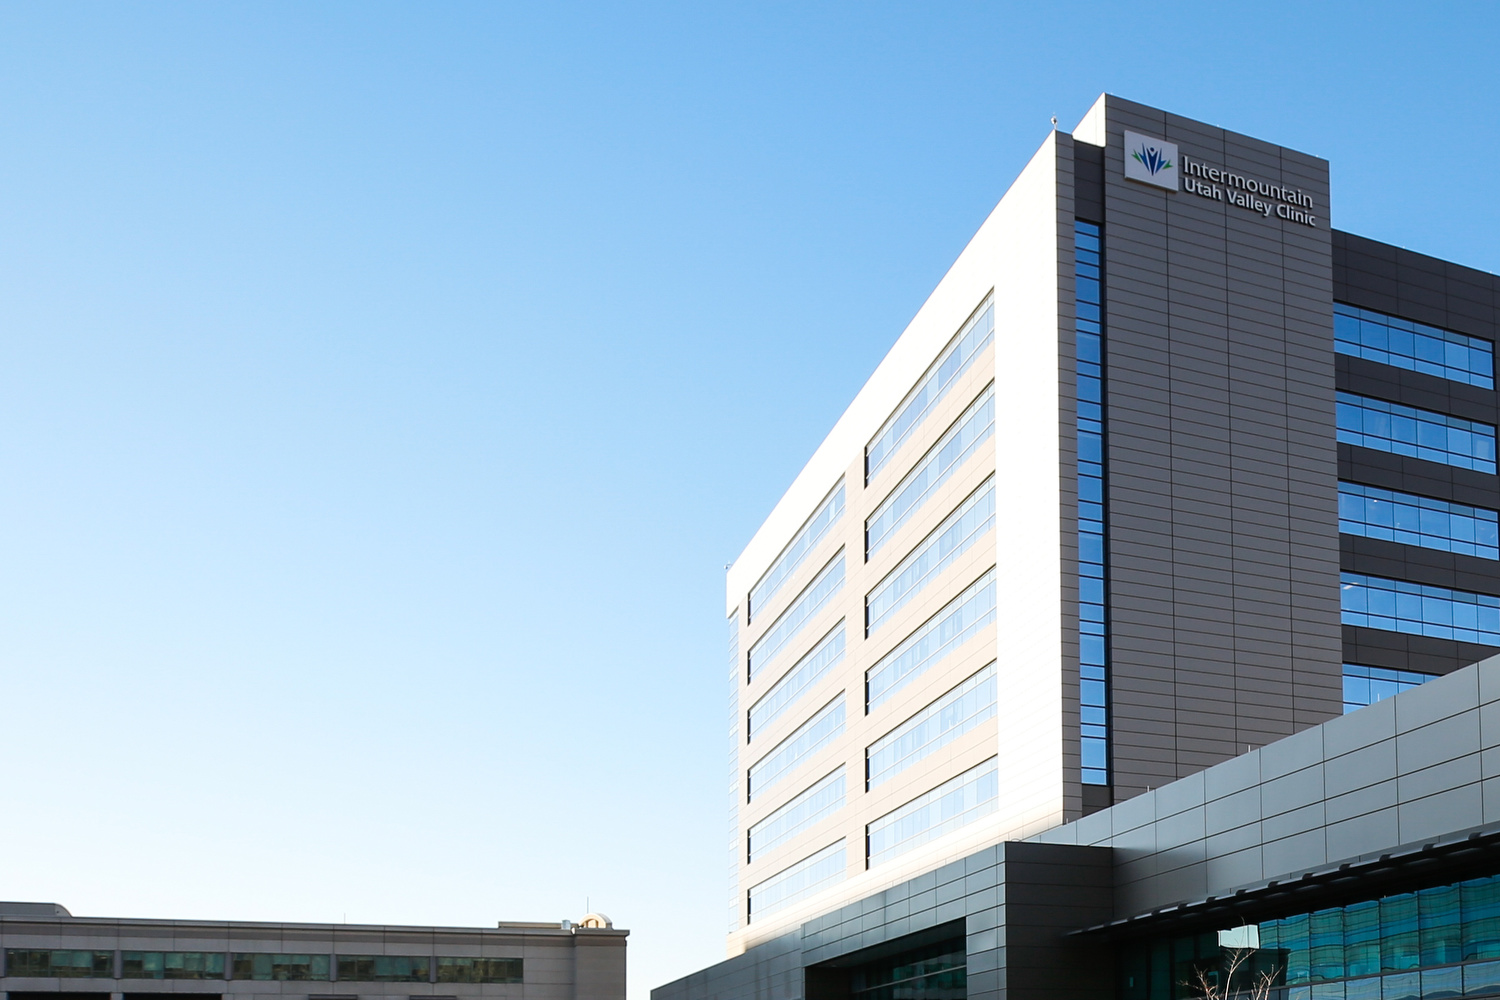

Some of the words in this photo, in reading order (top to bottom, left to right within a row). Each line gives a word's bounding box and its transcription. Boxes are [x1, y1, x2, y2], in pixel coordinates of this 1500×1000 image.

[1183, 155, 1313, 209] Intermountain
[1183, 177, 1222, 200] Utah
[1226, 188, 1272, 217] Valley
[1276, 204, 1316, 227] Clinic
